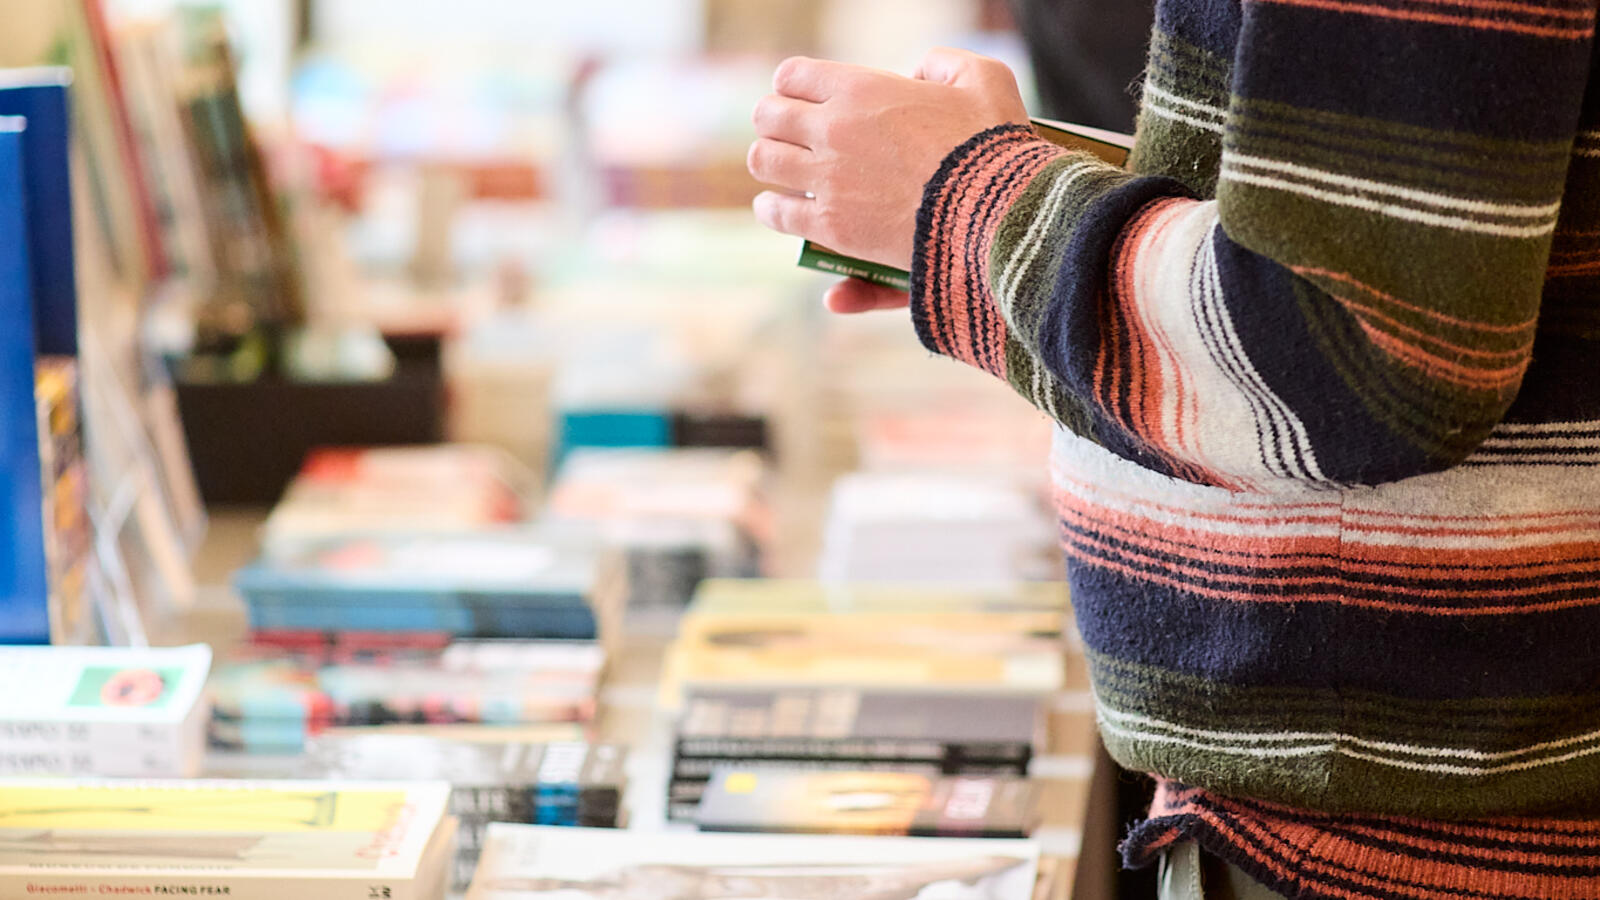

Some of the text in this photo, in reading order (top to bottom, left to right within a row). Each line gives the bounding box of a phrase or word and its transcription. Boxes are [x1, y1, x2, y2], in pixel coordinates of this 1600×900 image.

[98, 883, 152, 896] Chadwick
[154, 884, 198, 896] FACING
[200, 885, 231, 896] FEAR
